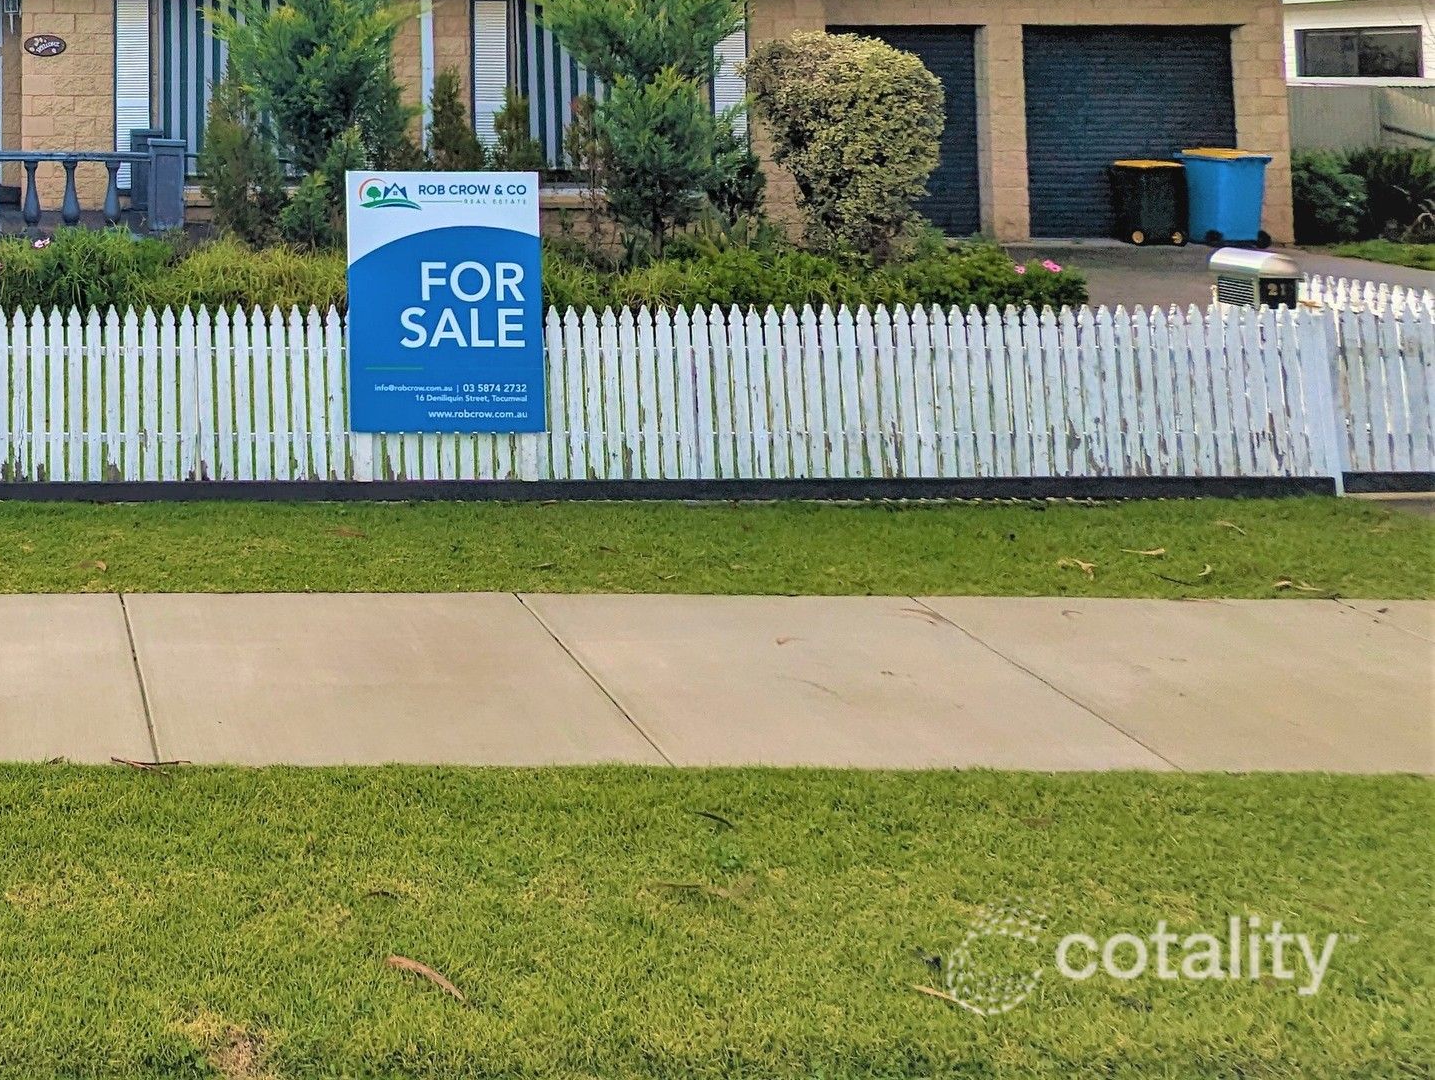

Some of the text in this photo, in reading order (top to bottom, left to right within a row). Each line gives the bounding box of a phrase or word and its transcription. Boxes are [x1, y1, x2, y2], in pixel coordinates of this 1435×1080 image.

[418, 185, 527, 195] ROB CROW & CO
[421, 261, 525, 302] FOR
[400, 307, 525, 348] SALE
[374, 384, 527, 392] info@robcrow.com.au 03 5874 2732
[427, 394, 463, 403] Deniliquin
[465, 394, 490, 403] Street,
[492, 394, 528, 402] Tocumwal
[429, 410, 528, 418] www.robcrow.com.au
